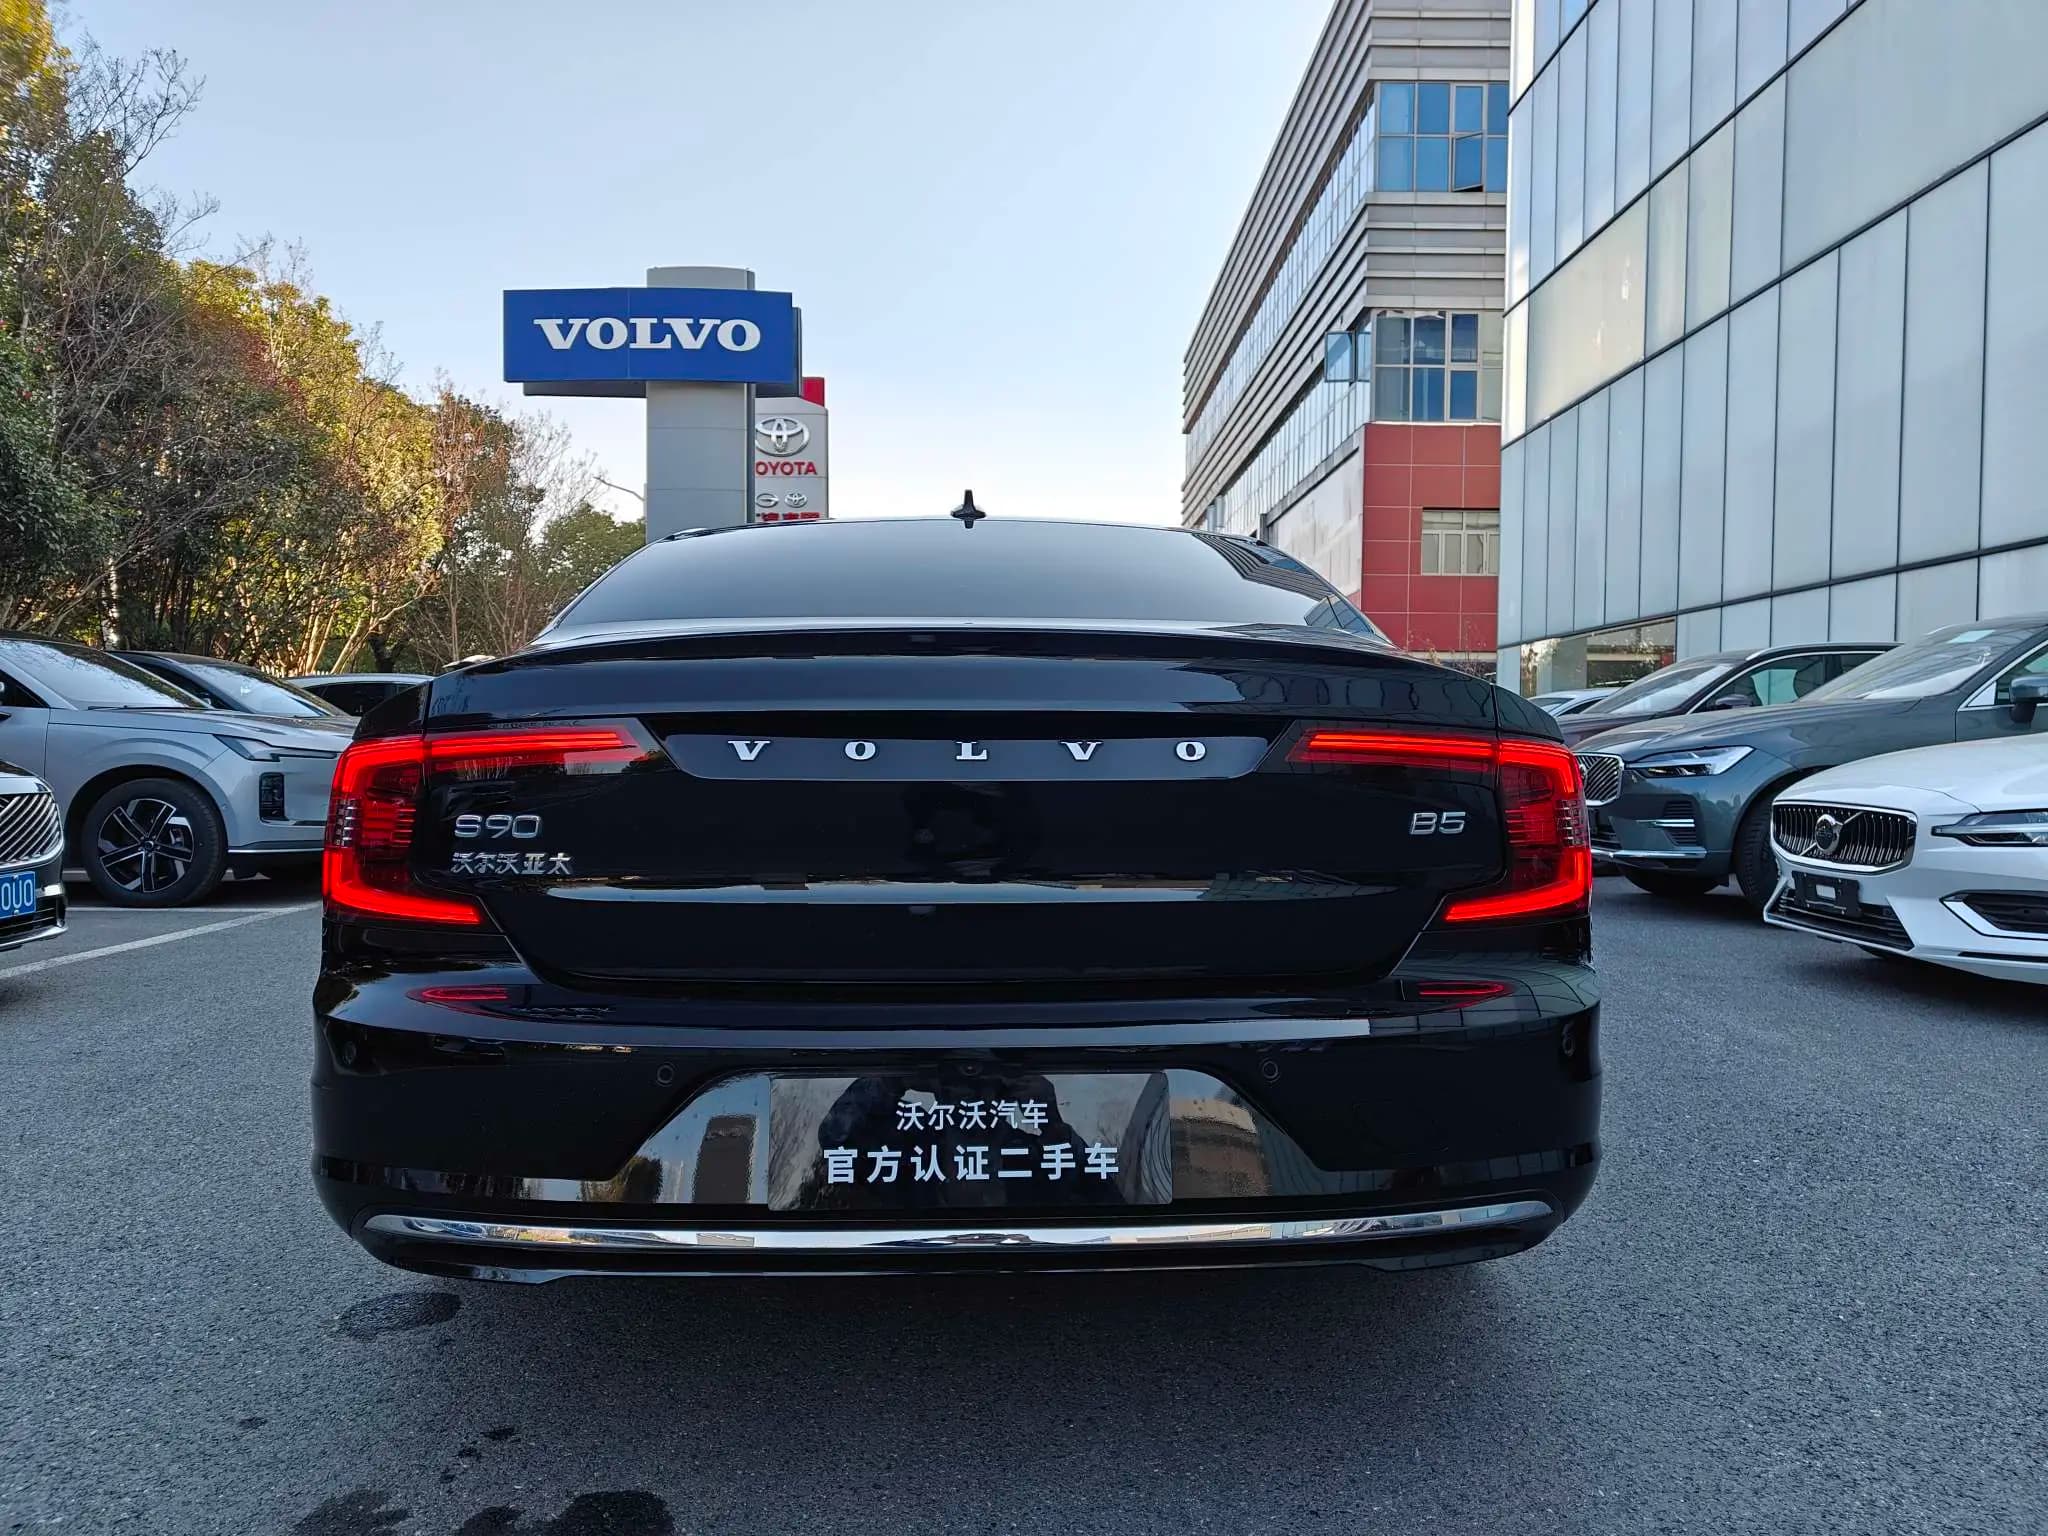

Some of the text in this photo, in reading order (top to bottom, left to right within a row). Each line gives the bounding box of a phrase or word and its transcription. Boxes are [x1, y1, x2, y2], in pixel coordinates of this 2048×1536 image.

[533, 317, 762, 352] VOLVO
[755, 461, 818, 476] OYOTA
[728, 740, 1207, 762] VOLVO
[454, 814, 542, 839] S90
[1410, 811, 1466, 834] B5
[450, 851, 573, 875] 沃尔沃亚太
[896, 1099, 1049, 1131] 沃尔沃汽车
[823, 1142, 1120, 1184] 官方认证二手车
